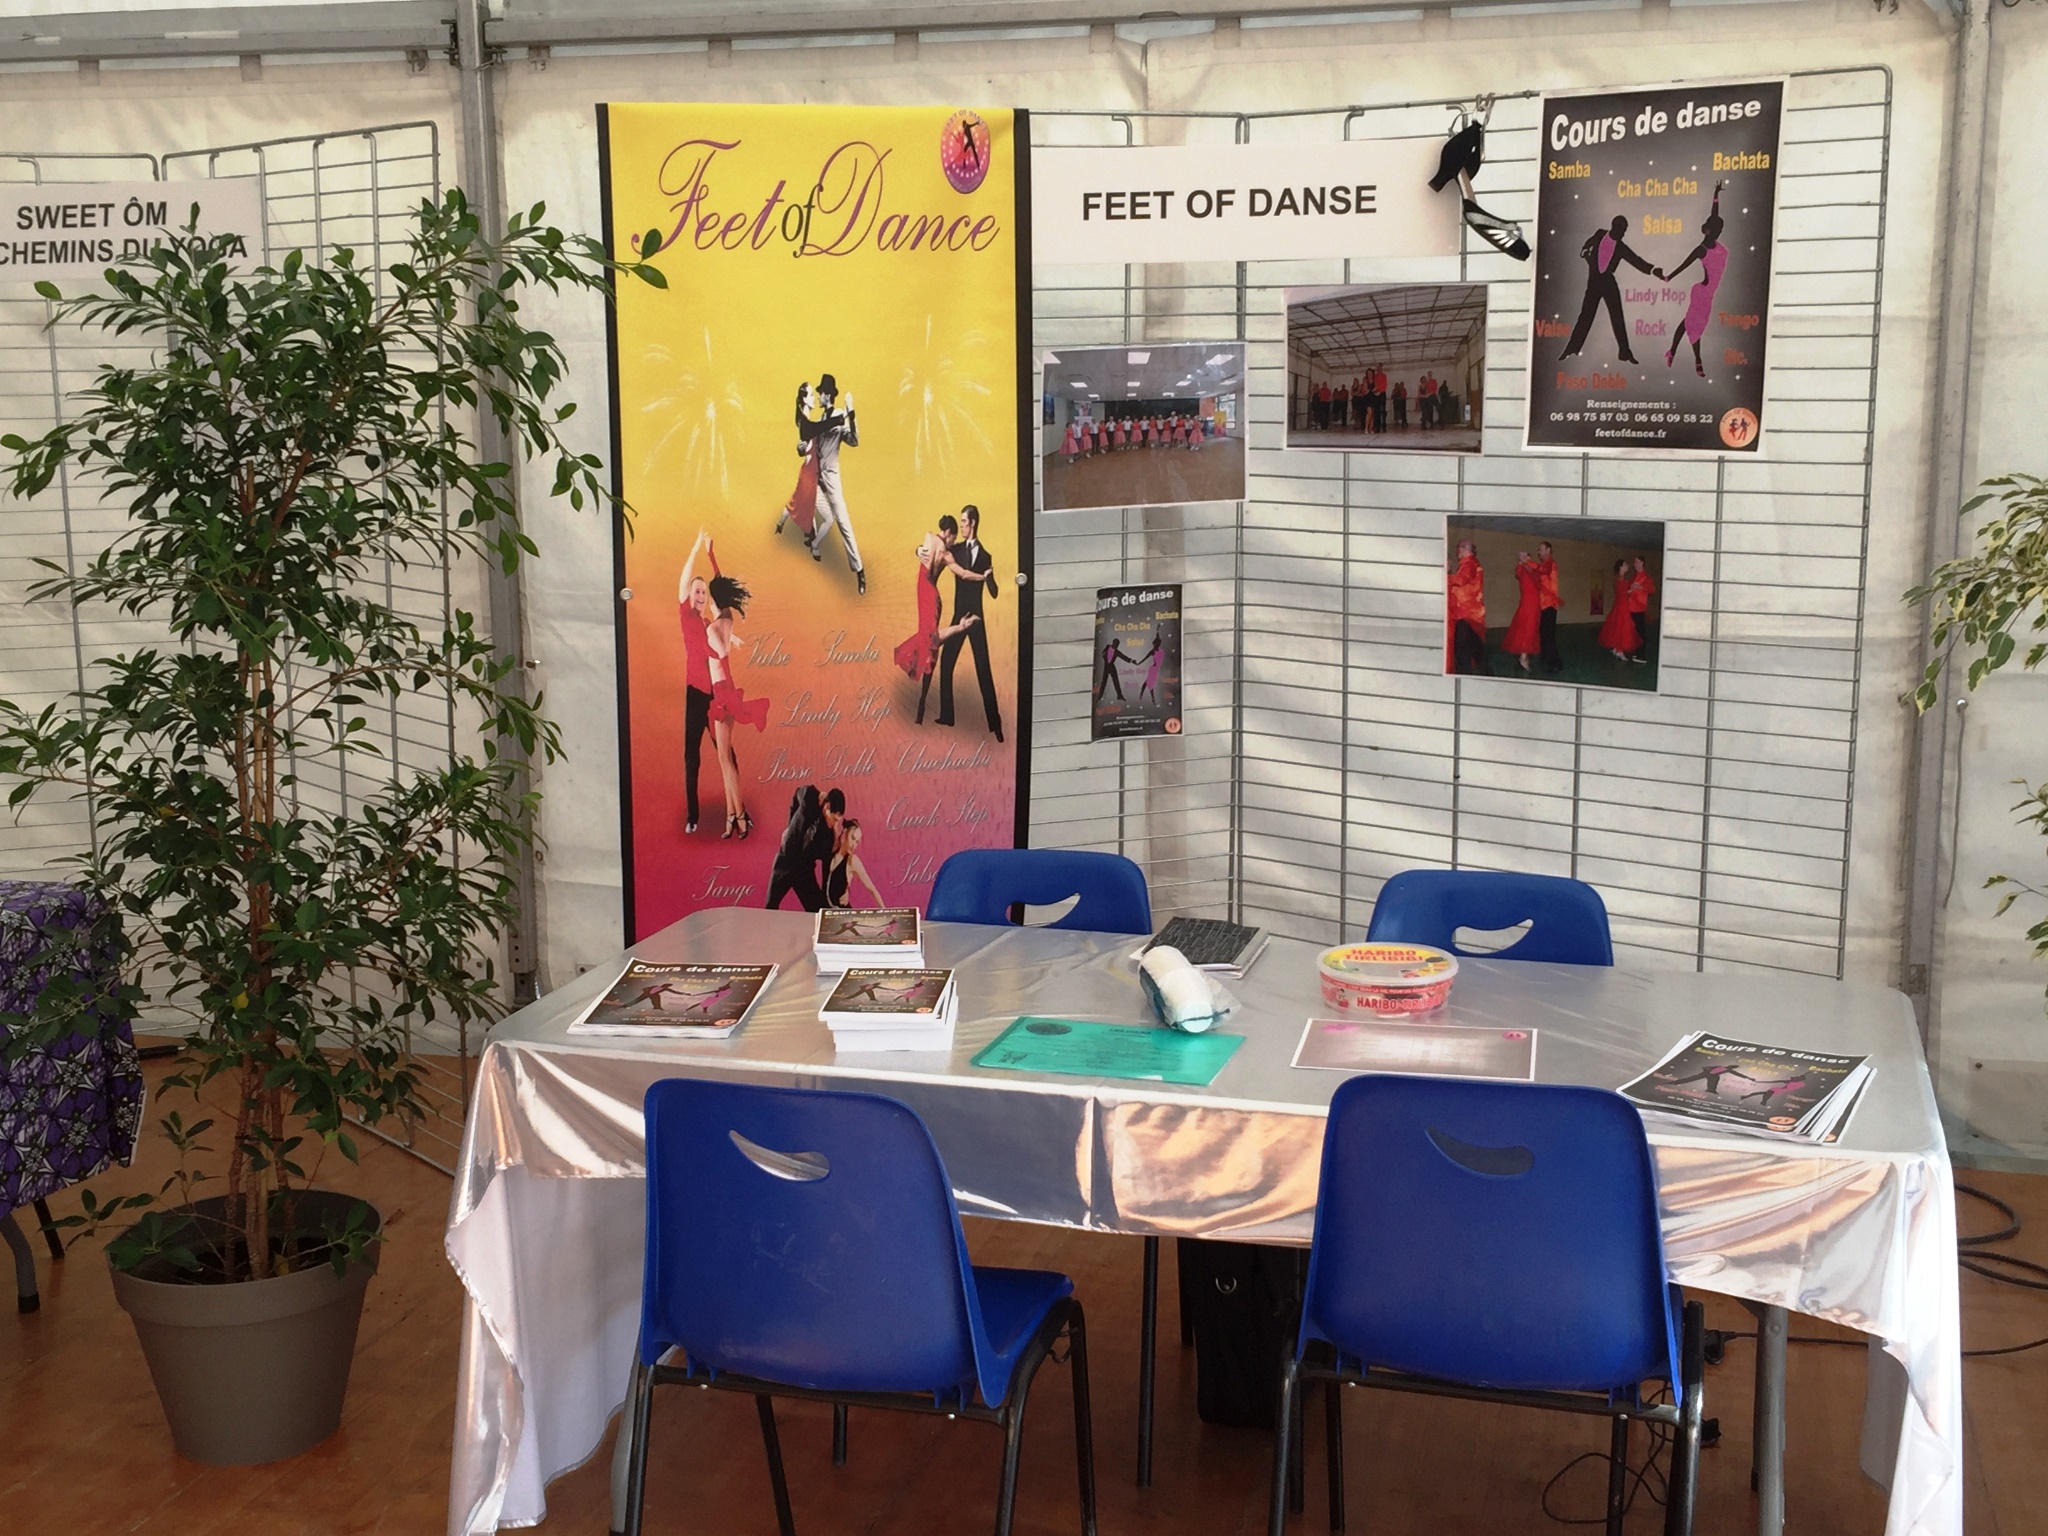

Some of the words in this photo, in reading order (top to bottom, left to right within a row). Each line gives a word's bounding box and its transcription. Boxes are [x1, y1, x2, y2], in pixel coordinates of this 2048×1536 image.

[1550, 114, 1626, 151] Cours
[1635, 105, 1668, 136] de
[1676, 100, 1761, 129] danse
[1549, 160, 1591, 179] Samba
[1713, 150, 1770, 171] Bachata
[632, 139, 785, 255] Feet
[1617, 180, 1641, 198] Cha
[1645, 178, 1669, 197] Cha
[1672, 177, 1697, 195] Cha
[800, 141, 1000, 256] Dance
[1083, 190, 1175, 221] FEET
[1186, 188, 1236, 218] OF
[1249, 184, 1377, 217] DANSE
[16, 203, 115, 230] SWEET
[123, 197, 167, 227] ÔM
[781, 183, 824, 258] of
[1643, 215, 1682, 235] Salsa
[1624, 288, 1659, 305] Lindy
[1661, 288, 1686, 306] Hop
[1635, 319, 1666, 336] Rock
[1556, 371, 1588, 390] Paso
[1592, 372, 1627, 391] Doble
[1586, 400, 1670, 410] Renseignements
[1550, 412, 1563, 421] 06
[1566, 412, 1580, 421] 98
[1583, 412, 1597, 422] 75
[1599, 412, 1612, 422] 87
[1615, 412, 1629, 422] 03
[1634, 412, 1648, 422] 06
[1650, 413, 1664, 422] 65
[1667, 413, 1680, 423] 09
[1683, 414, 1697, 423] 58
[1699, 414, 1713, 423] 22
[1595, 428, 1667, 438] feetofdance.fr
[1121, 592, 1136, 606] de
[1139, 590, 1174, 603] danse
[746, 632, 792, 669] Valse
[814, 630, 880, 667] Samba
[778, 691, 841, 738] Lindy
[850, 686, 893, 732] Hop
[692, 864, 756, 906] Tango
[633, 964, 681, 973] Cours
[1357, 997, 1397, 1009] HARIBO
[1702, 1039, 1757, 1052] Cours
[1762, 1048, 1786, 1056] de
[1791, 1052, 1850, 1064] danse
